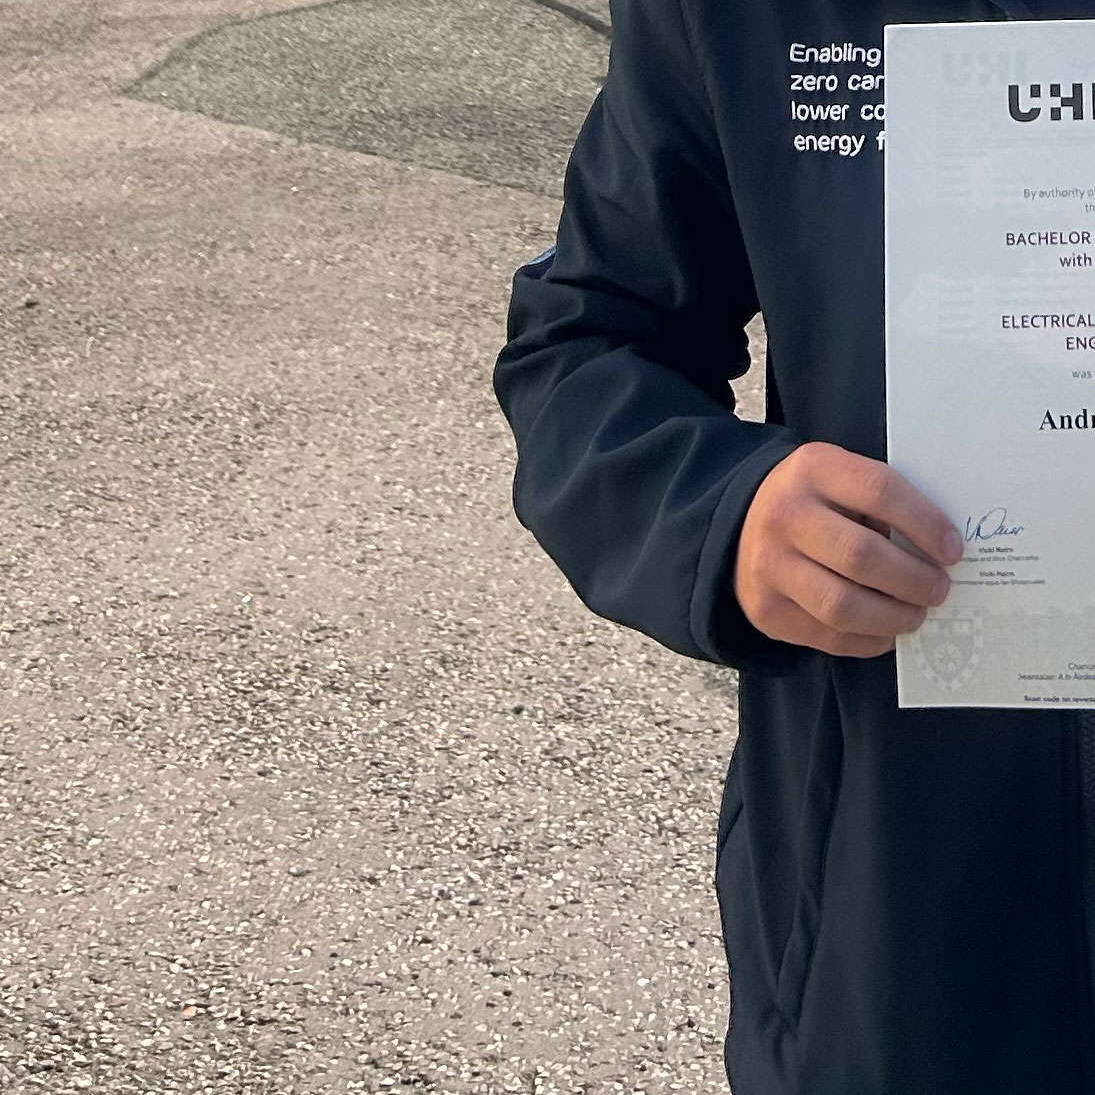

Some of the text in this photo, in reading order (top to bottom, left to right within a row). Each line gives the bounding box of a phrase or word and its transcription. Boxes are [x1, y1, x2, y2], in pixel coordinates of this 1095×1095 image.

[790, 43, 881, 67] Enabling
[791, 74, 838, 91] zero
[791, 100, 849, 121] lower
[793, 134, 865, 157] energy
[1023, 188, 1036, 200] By
[1039, 188, 1084, 199] authority
[1006, 231, 1091, 246] BACHELOR
[1060, 253, 1092, 267] with
[1002, 314, 1095, 328] ELECTRICAL
[1072, 370, 1092, 379] was
